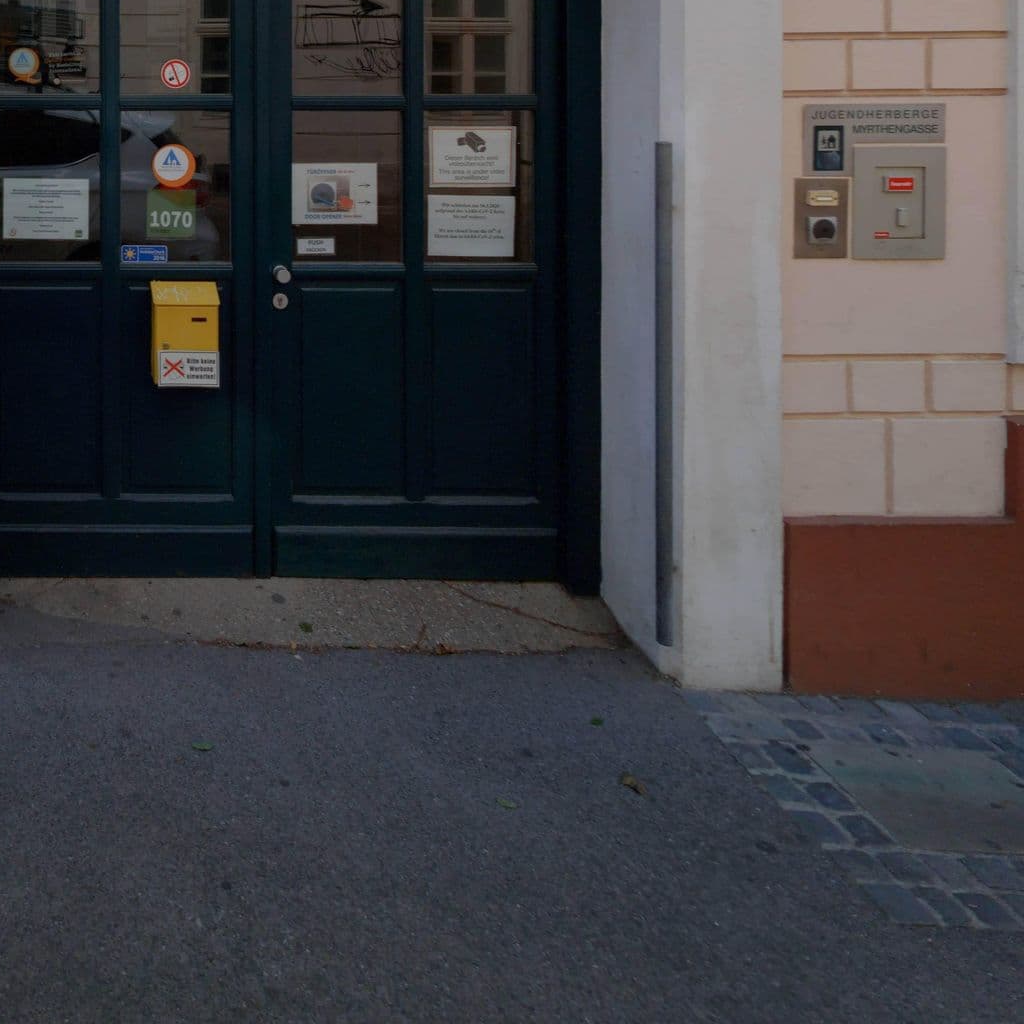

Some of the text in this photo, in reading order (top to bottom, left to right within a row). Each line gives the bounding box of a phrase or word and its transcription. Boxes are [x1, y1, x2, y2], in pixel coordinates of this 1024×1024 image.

[811, 109, 939, 120] JUGENDHERBERGE
[852, 125, 939, 134] MYRTHENGASSE
[149, 210, 193, 228] 1070
